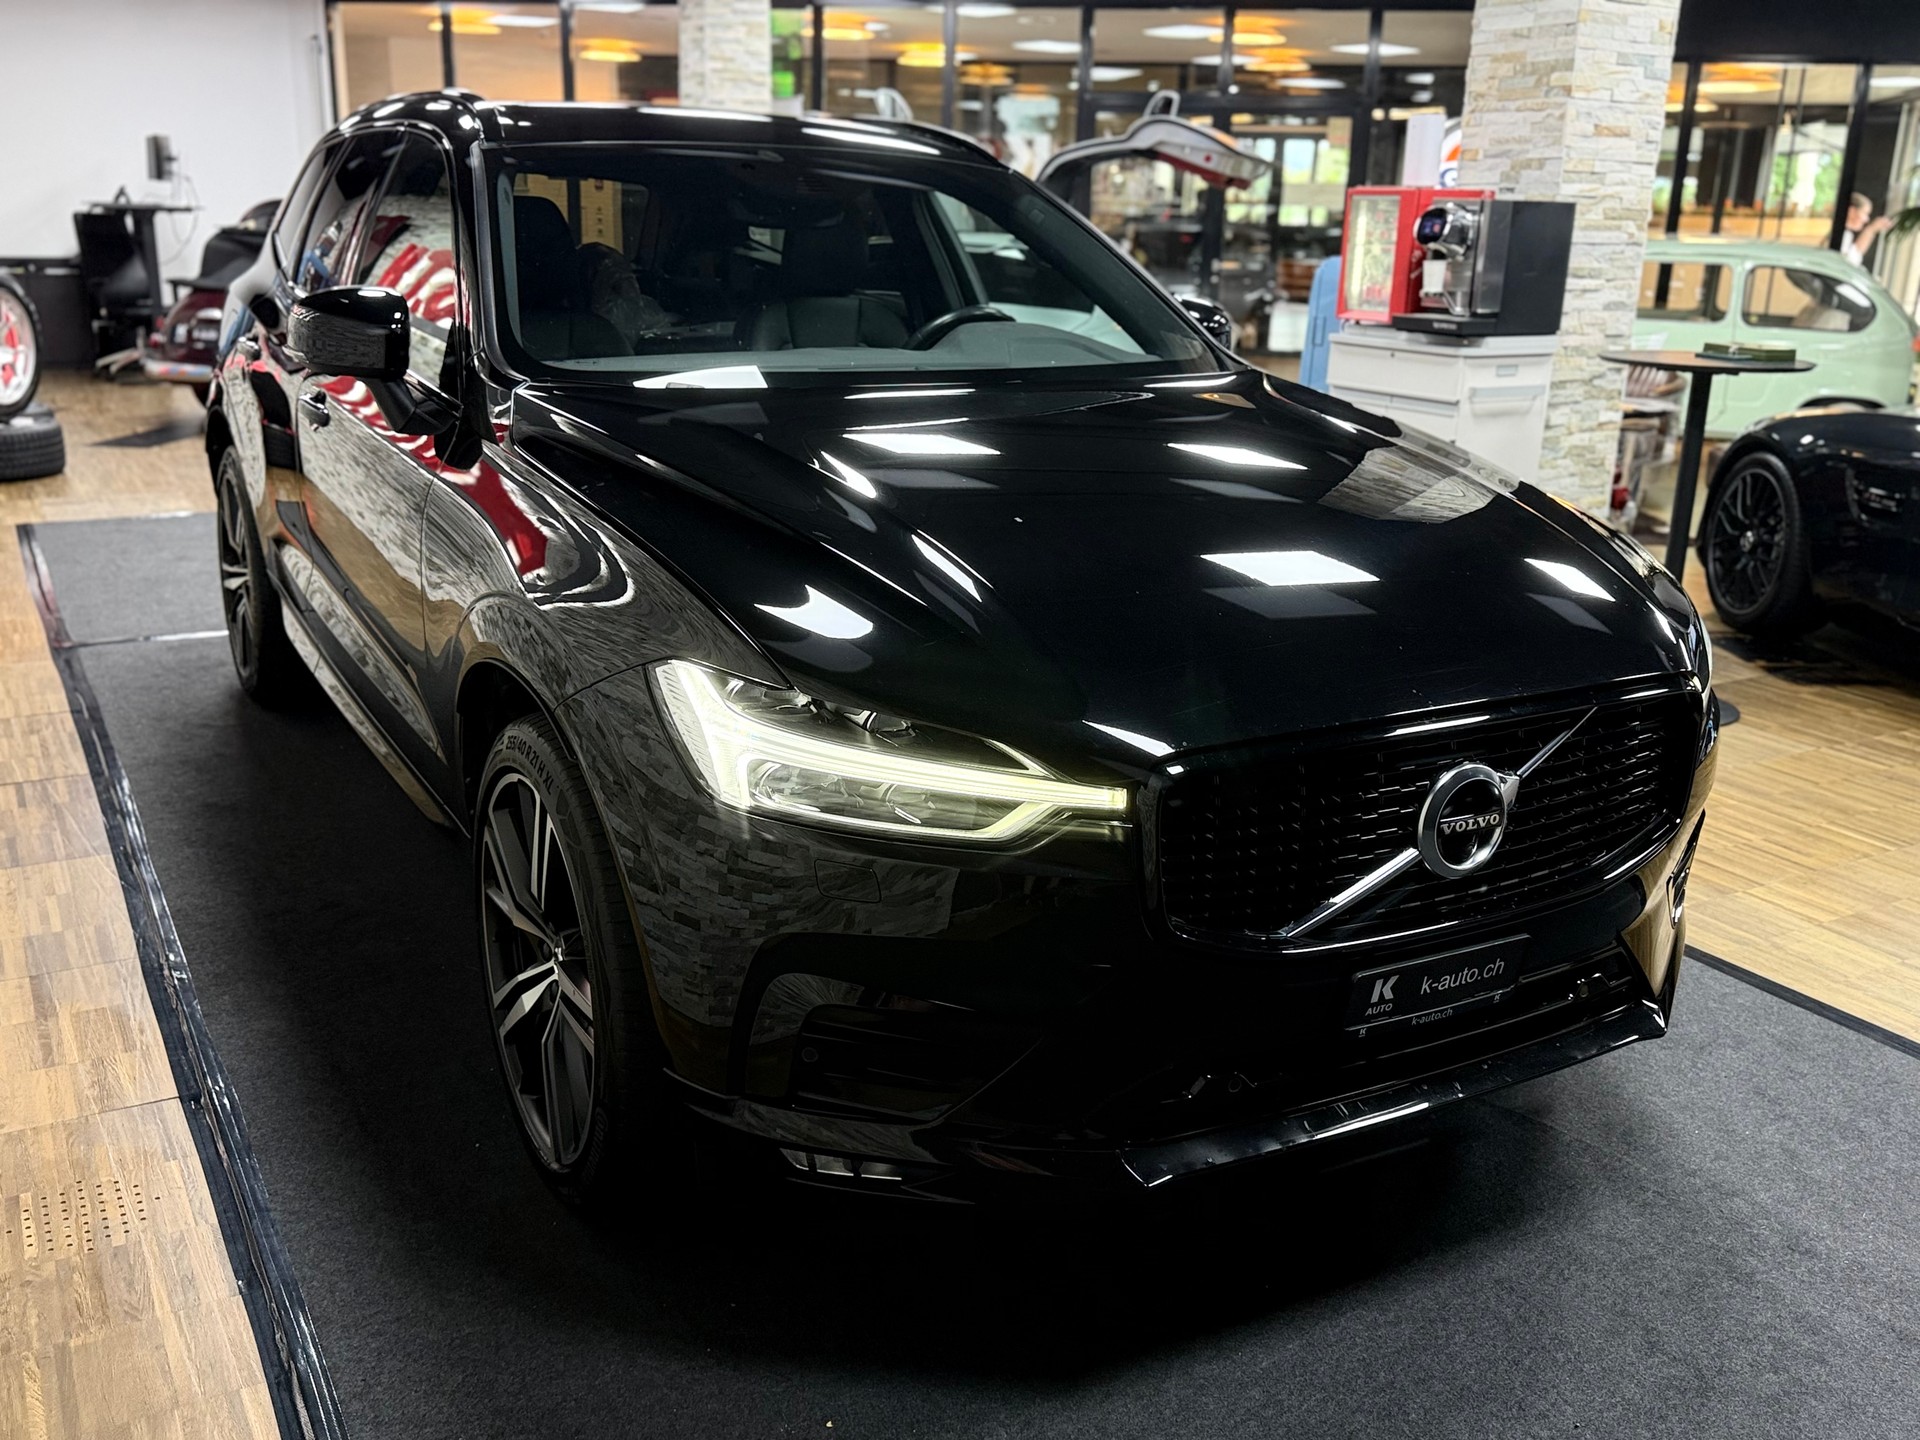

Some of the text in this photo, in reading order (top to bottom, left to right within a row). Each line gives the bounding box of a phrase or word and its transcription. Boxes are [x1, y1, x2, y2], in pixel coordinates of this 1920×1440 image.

[506, 735, 527, 756] 255/40
[529, 750, 540, 769] 21
[537, 759, 546, 778] H
[543, 771, 554, 796] XL
[1440, 813, 1500, 836] VOLVO
[1370, 958, 1505, 1004] K k-auto.ch
[1364, 1003, 1393, 1017] AUTO
[1411, 1007, 1454, 1027] k-auto.ch
